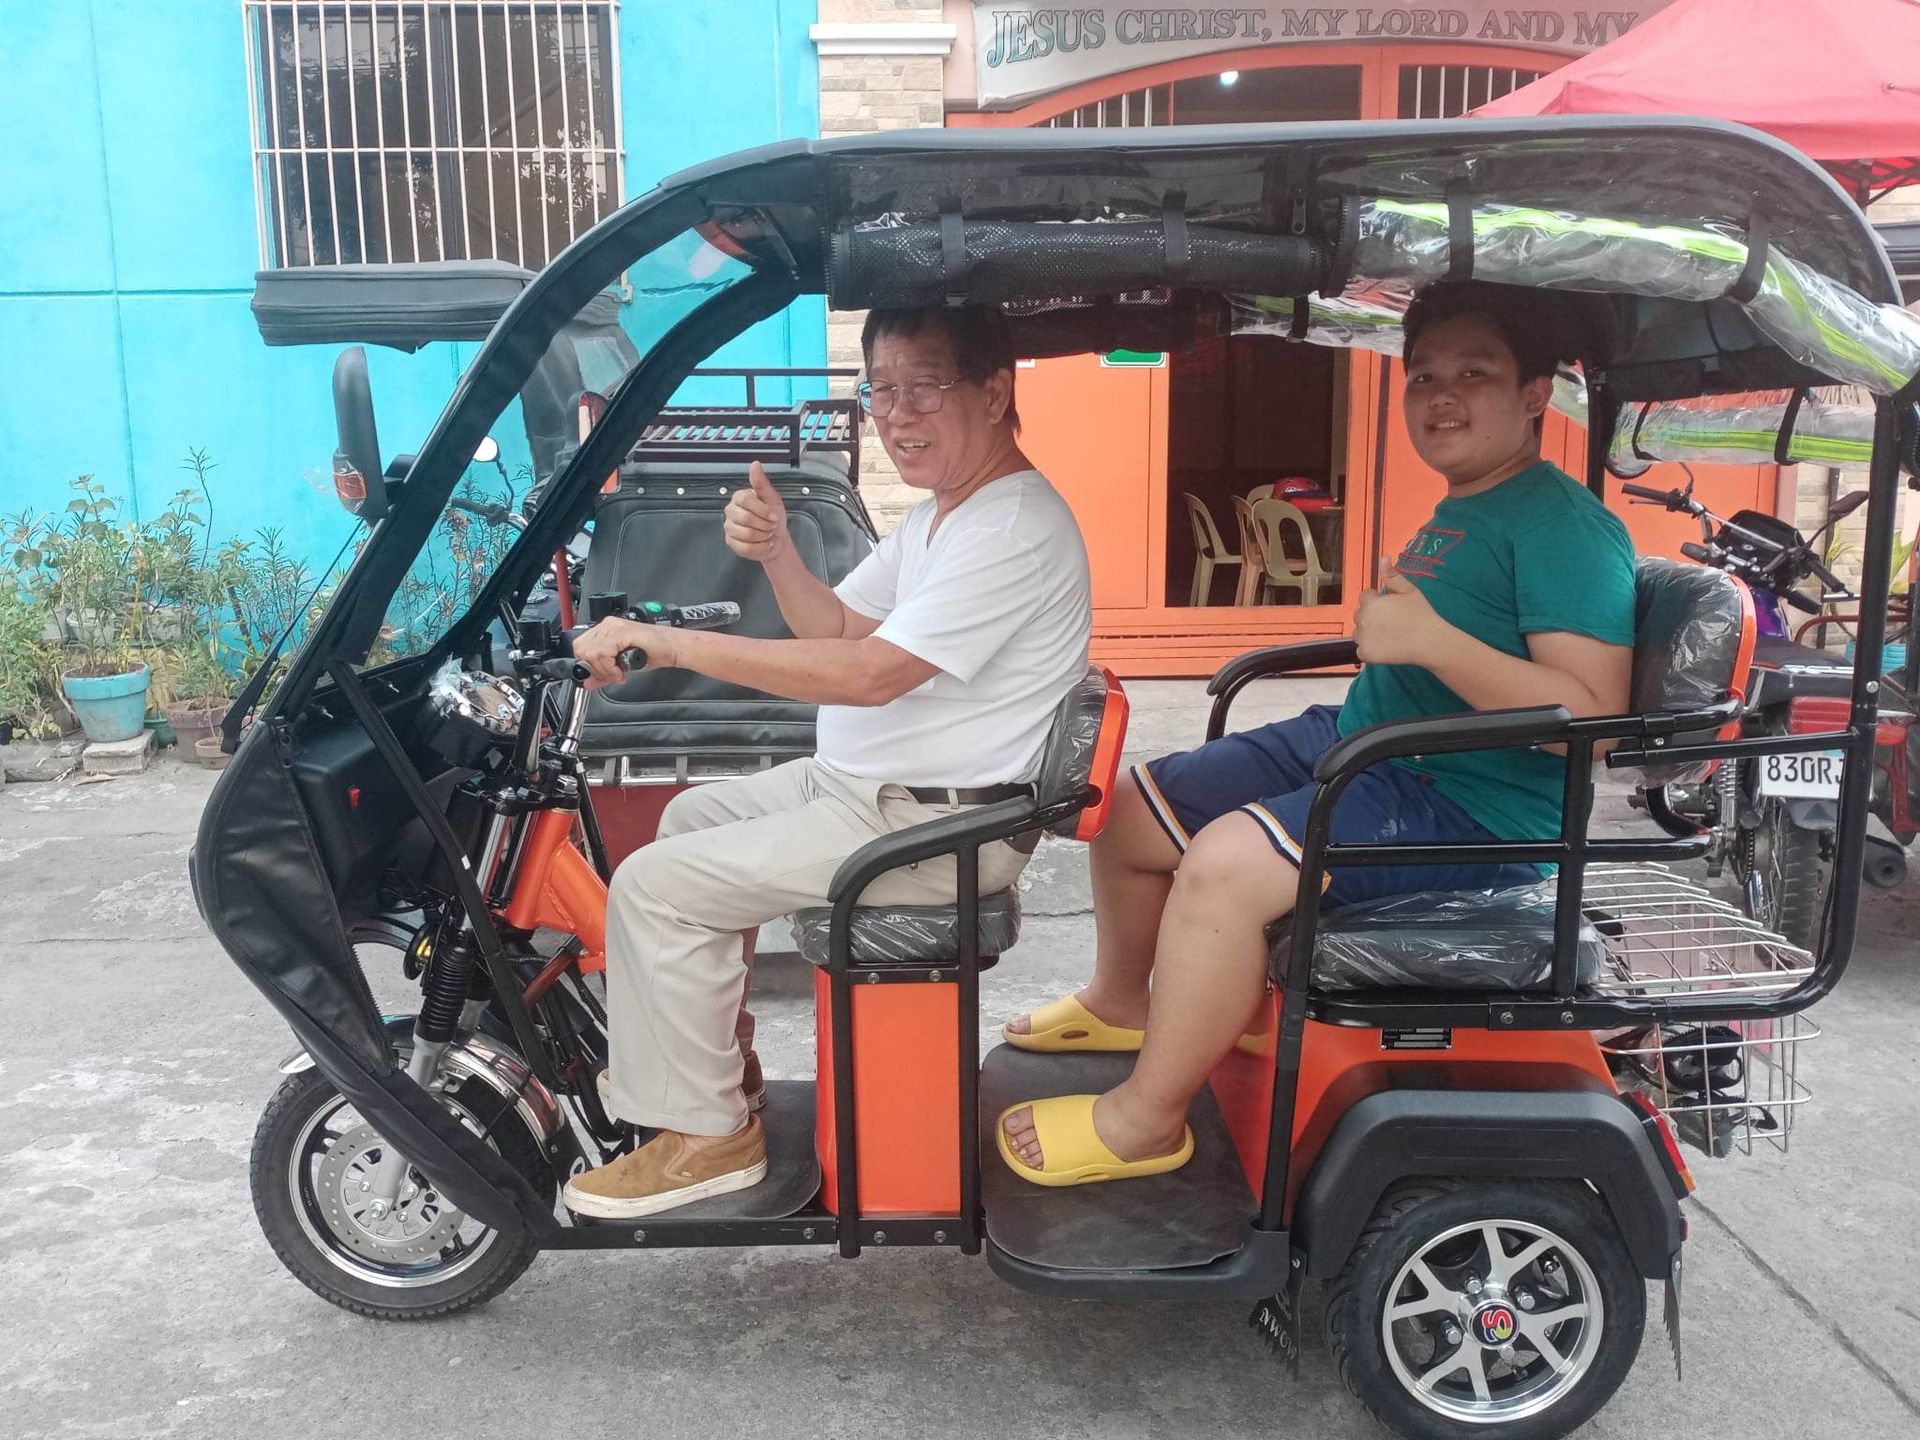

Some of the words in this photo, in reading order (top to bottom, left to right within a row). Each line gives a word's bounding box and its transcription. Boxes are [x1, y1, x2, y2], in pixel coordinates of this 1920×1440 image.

[986, 9, 1106, 67] JESUS
[1115, 8, 1272, 45] CHRIST,
[1281, 9, 1348, 37] MY
[1355, 8, 1470, 38] LORD
[1477, 10, 1565, 42] AND
[1573, 11, 1640, 46] MY
